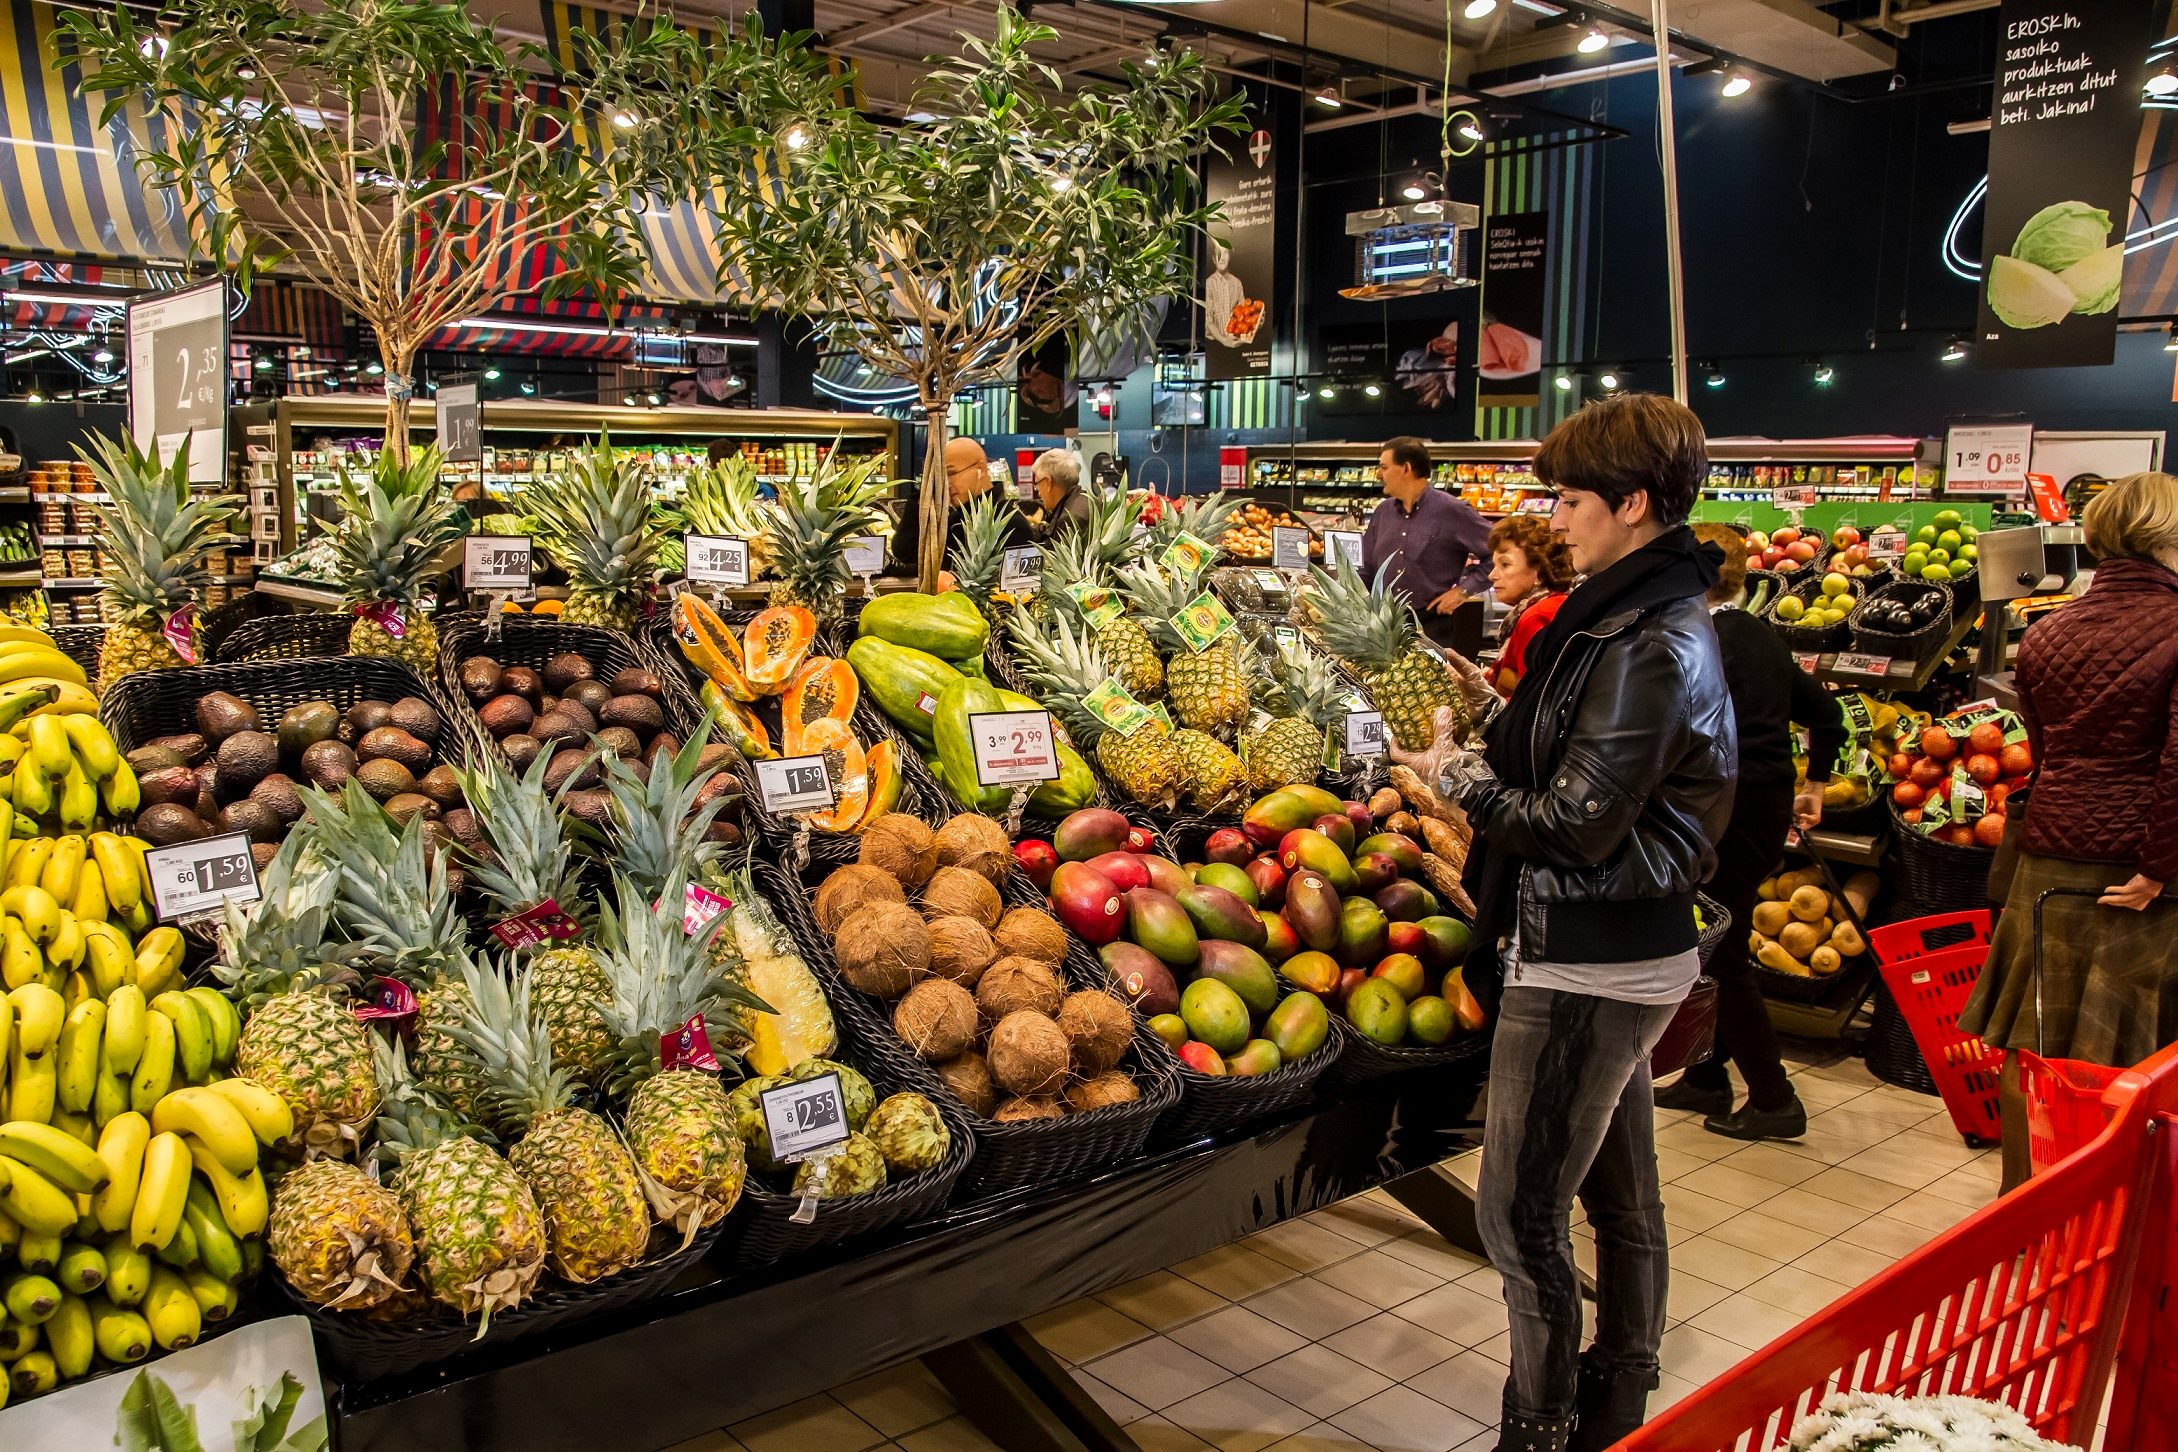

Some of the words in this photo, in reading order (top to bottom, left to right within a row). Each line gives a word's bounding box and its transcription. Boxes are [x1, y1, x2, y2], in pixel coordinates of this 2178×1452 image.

[2005, 38, 2059, 61] sasoiko
[2004, 52, 2092, 87] produktuak
[2002, 82, 2073, 104] aurkitzen
[2080, 69, 2117, 91] ditut
[2000, 106, 2030, 125] beti.
[2036, 94, 2094, 119] Jakina!
[1986, 333, 1999, 341] Aza
[176, 346, 217, 410] 2,35
[1956, 452, 1980, 468] 1,09
[1987, 453, 2021, 474] 0,85
[481, 557, 493, 565] 56
[494, 552, 528, 575] 4,99
[698, 553, 709, 561] 92
[710, 550, 740, 570] 4,25
[988, 735, 1006, 748] 3,99
[1011, 730, 1042, 754] 2,99
[790, 768, 821, 793] 1,59
[177, 871, 195, 883] 60
[200, 855, 248, 890] 1,59
[240, 874, 248, 883] €
[786, 1111, 794, 1123] 8
[798, 1092, 834, 1131] 2,55
